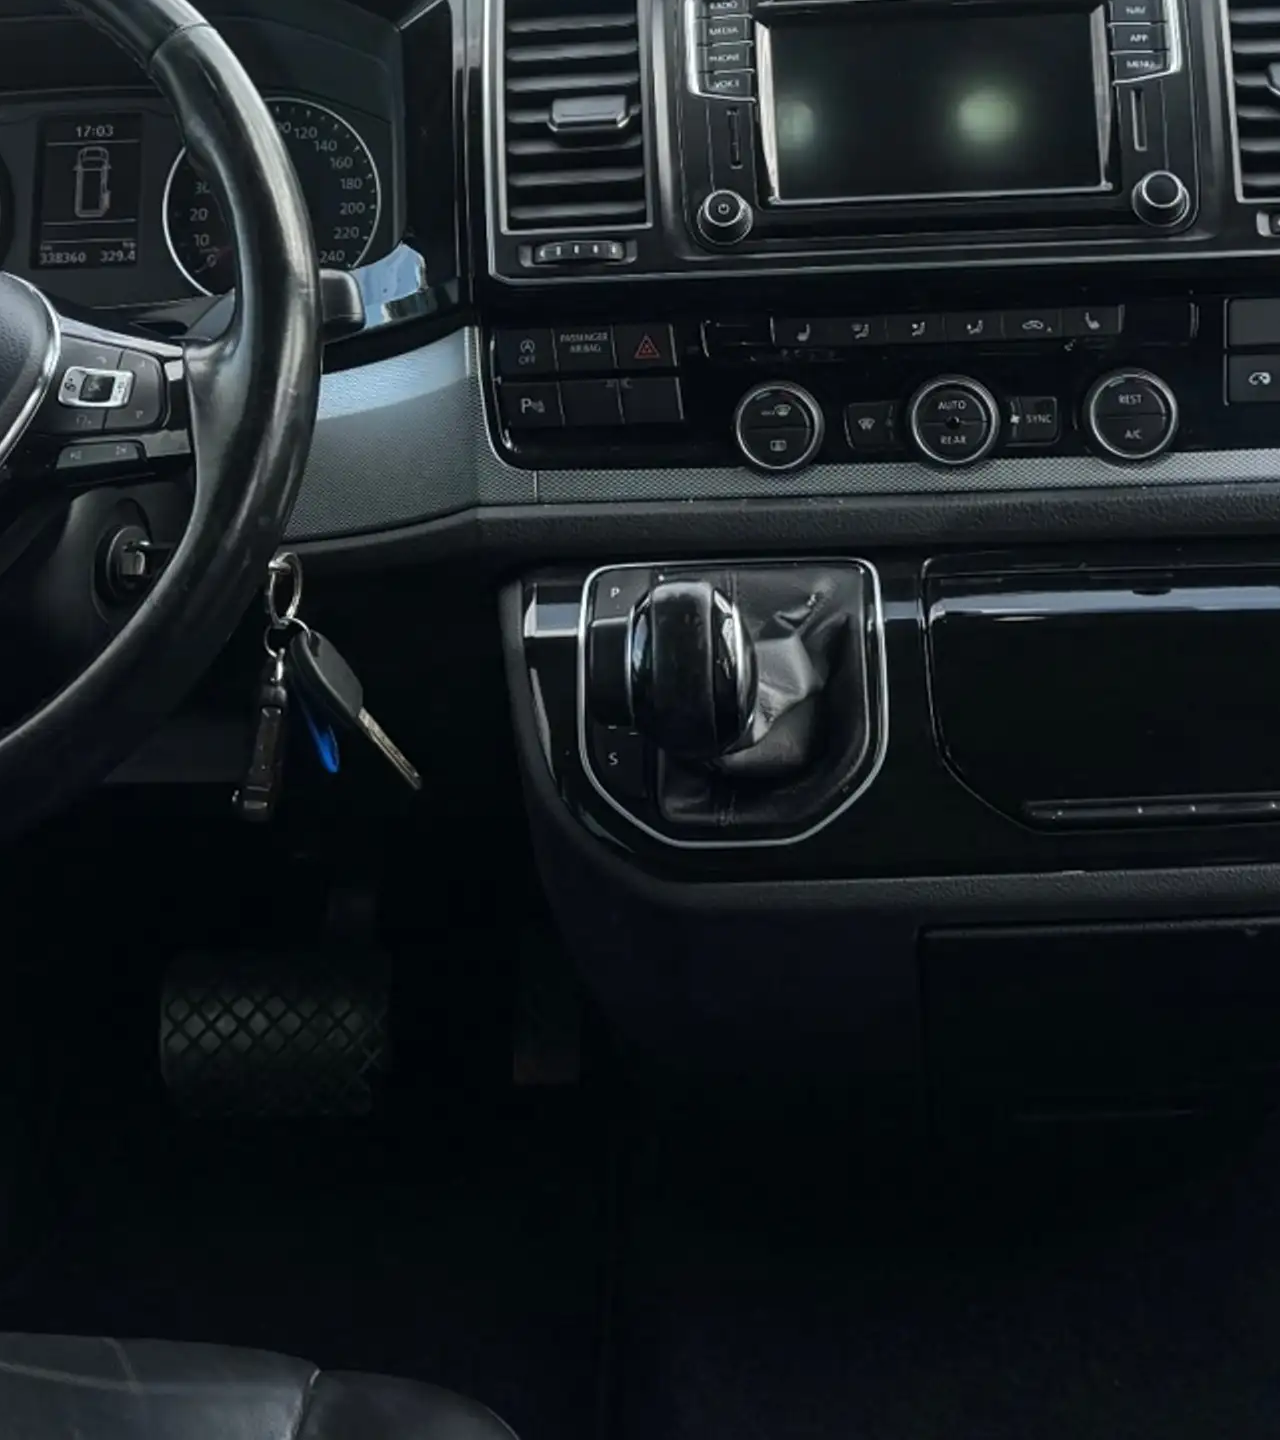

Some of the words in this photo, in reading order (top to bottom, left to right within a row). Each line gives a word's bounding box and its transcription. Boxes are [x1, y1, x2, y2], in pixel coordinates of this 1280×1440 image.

[1130, 34, 1148, 42] APP
[76, 124, 114, 137] 17:03
[294, 126, 317, 139] 120
[314, 140, 338, 152] 140
[330, 156, 353, 169] 160
[340, 177, 362, 190] 180
[339, 202, 365, 215] 200
[189, 208, 208, 222] 20
[333, 227, 359, 240] 220
[193, 234, 209, 247] 10
[320, 250, 345, 263] 240
[560, 332, 608, 343] PASSENGER
[570, 343, 601, 353] AIRBAG
[938, 400, 966, 410] AUTO
[1119, 394, 1142, 404] REST
[1026, 414, 1052, 424] SYNC
[940, 436, 966, 445] REAR
[1125, 429, 1142, 440] A/C
[610, 587, 620, 598] P
[608, 752, 619, 766] S
